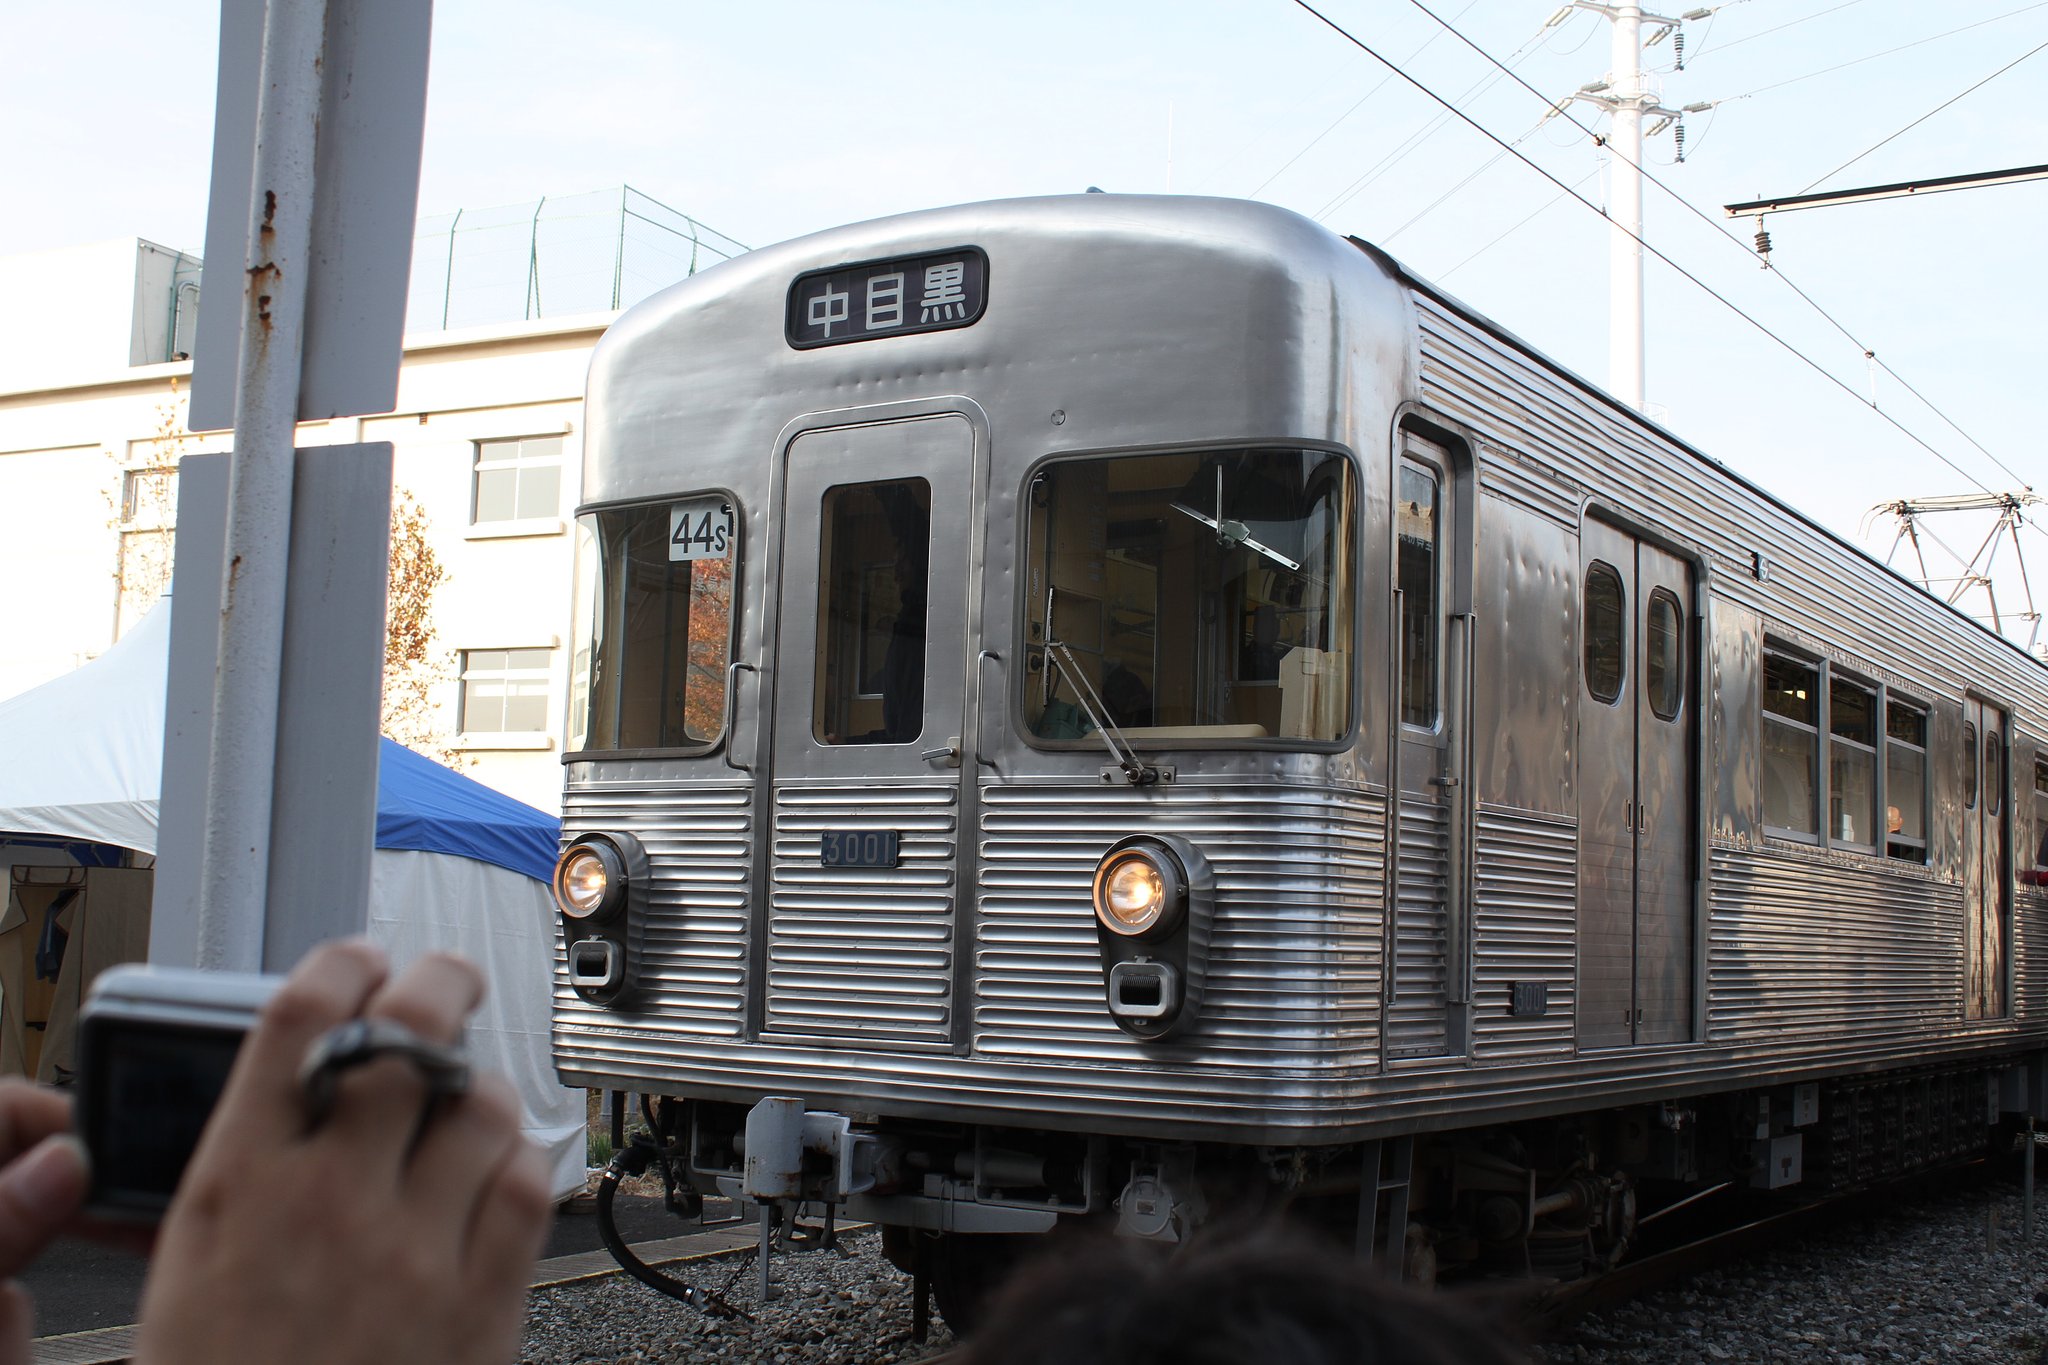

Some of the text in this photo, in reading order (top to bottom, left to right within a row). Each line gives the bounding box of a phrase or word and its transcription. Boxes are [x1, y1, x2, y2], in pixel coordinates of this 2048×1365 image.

[807, 261, 966, 338] 中目黒
[826, 833, 890, 864] 3001
